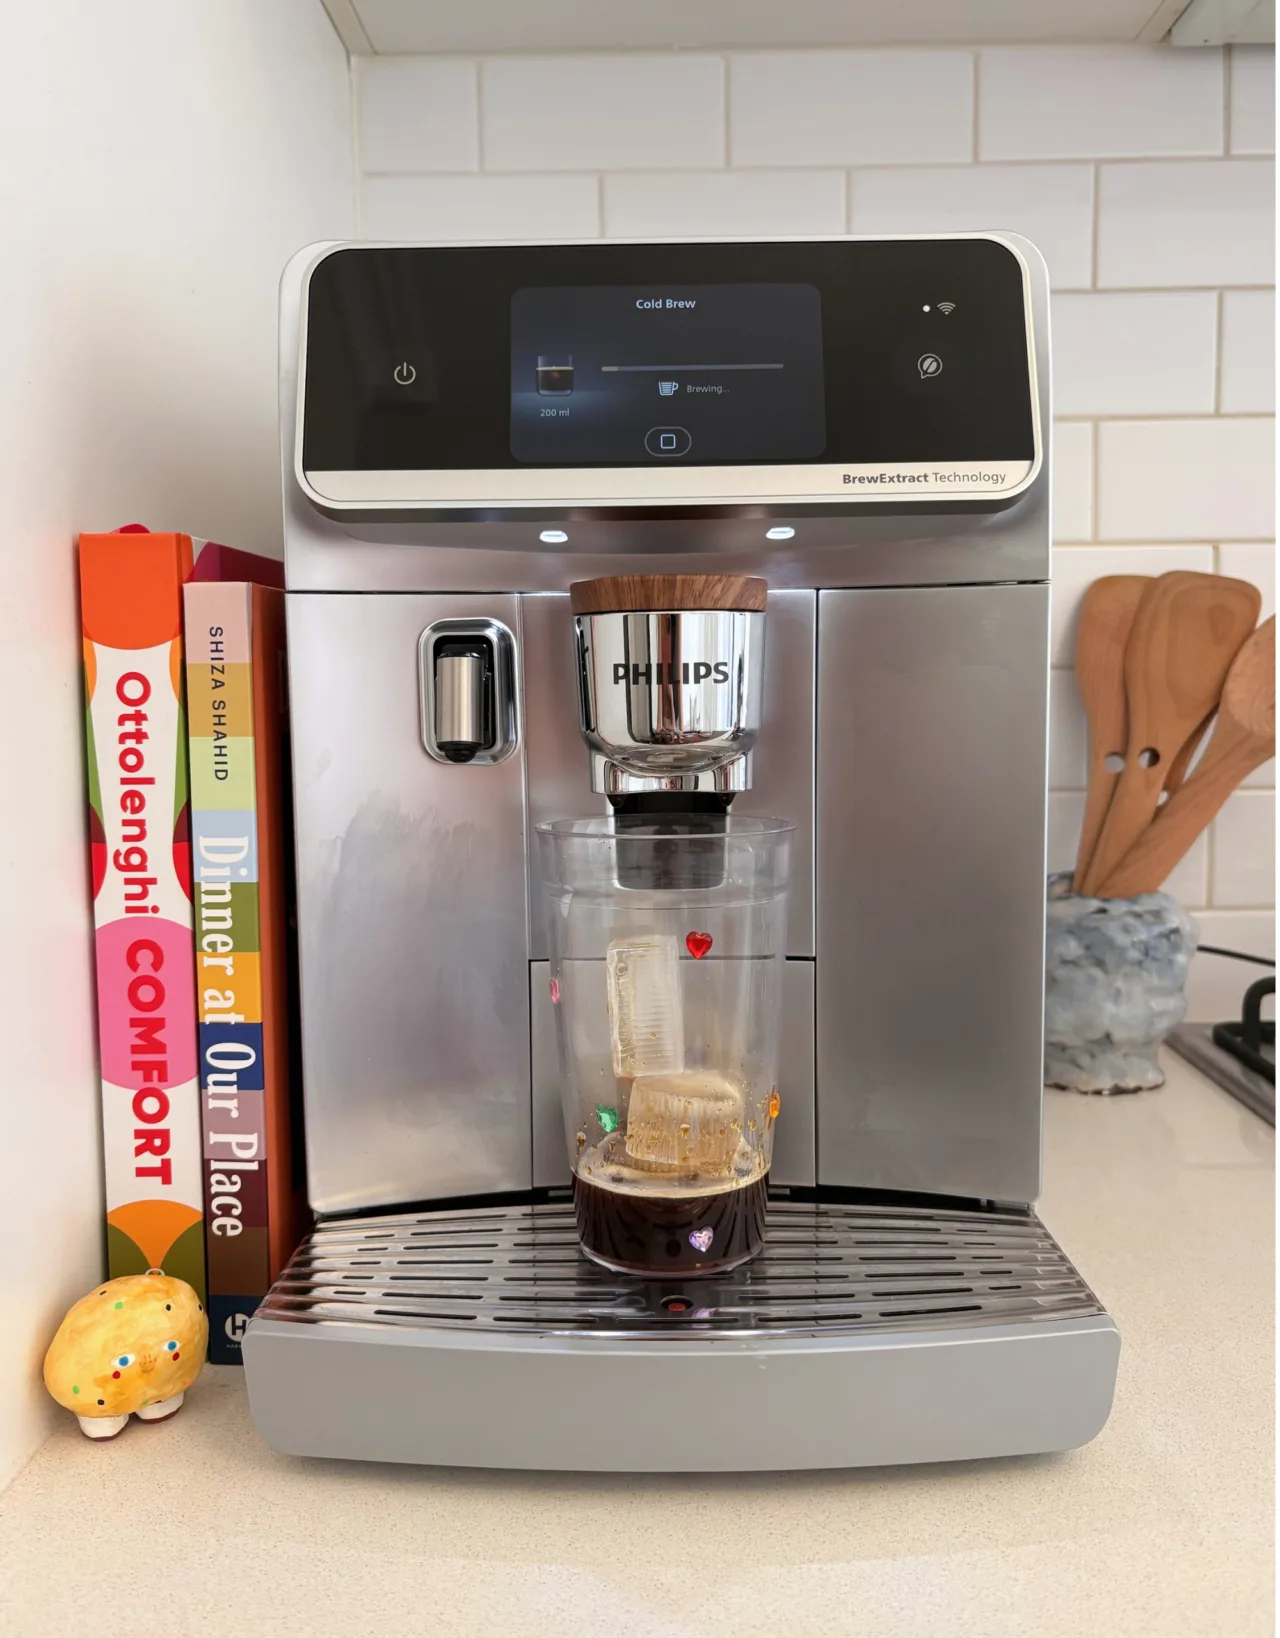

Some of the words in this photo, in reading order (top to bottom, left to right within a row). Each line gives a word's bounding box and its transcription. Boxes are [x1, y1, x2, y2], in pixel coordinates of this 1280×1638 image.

[636, 299, 662, 310] Cold
[666, 299, 696, 309] Brew
[540, 408, 558, 417] 200
[560, 408, 570, 417] ml
[686, 384, 730, 396] Brewing...
[842, 473, 929, 484] BrewExtract
[932, 472, 1006, 484] Technology
[209, 626, 225, 690] SHIZA
[613, 662, 730, 685] PHILIPS
[212, 700, 228, 781] SHAHID
[113, 671, 160, 915] Ottolenghi
[199, 836, 249, 976] Dinner
[203, 988, 246, 1026] at
[126, 938, 172, 1186] COMFORT
[205, 1041, 257, 1118] Our
[208, 1132, 259, 1237] Place
